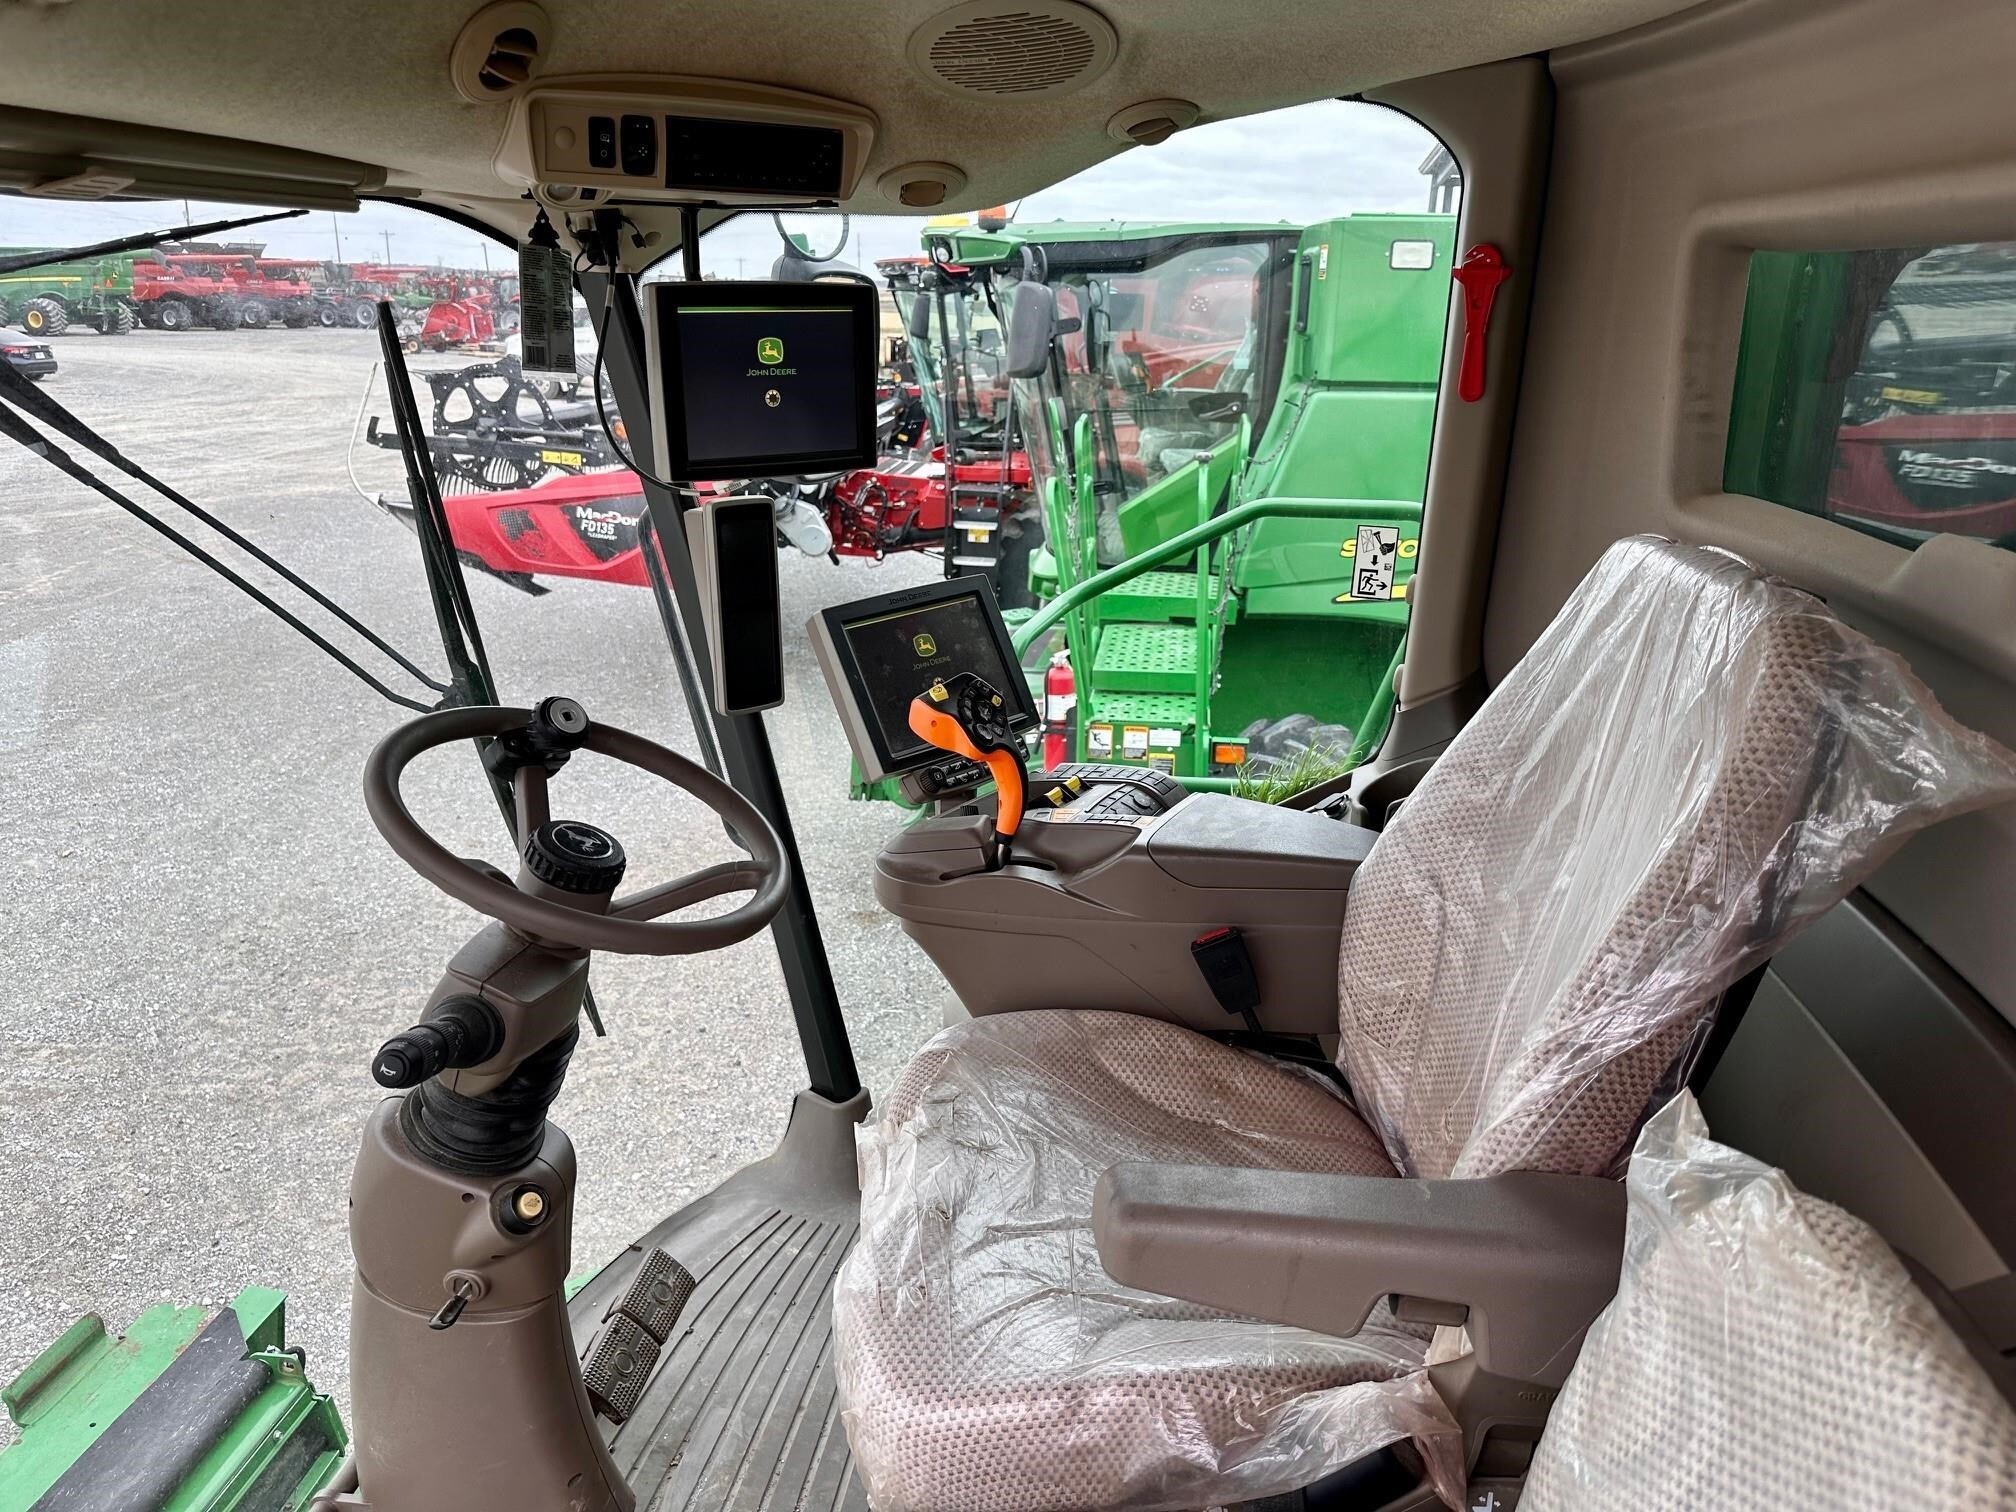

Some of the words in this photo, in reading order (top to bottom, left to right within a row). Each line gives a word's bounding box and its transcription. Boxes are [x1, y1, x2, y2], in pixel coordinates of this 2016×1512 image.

[746, 367, 769, 377] JOHN
[770, 367, 798, 376] DEERE
[581, 519, 615, 535] FD135
[1340, 538, 1419, 559] S0
